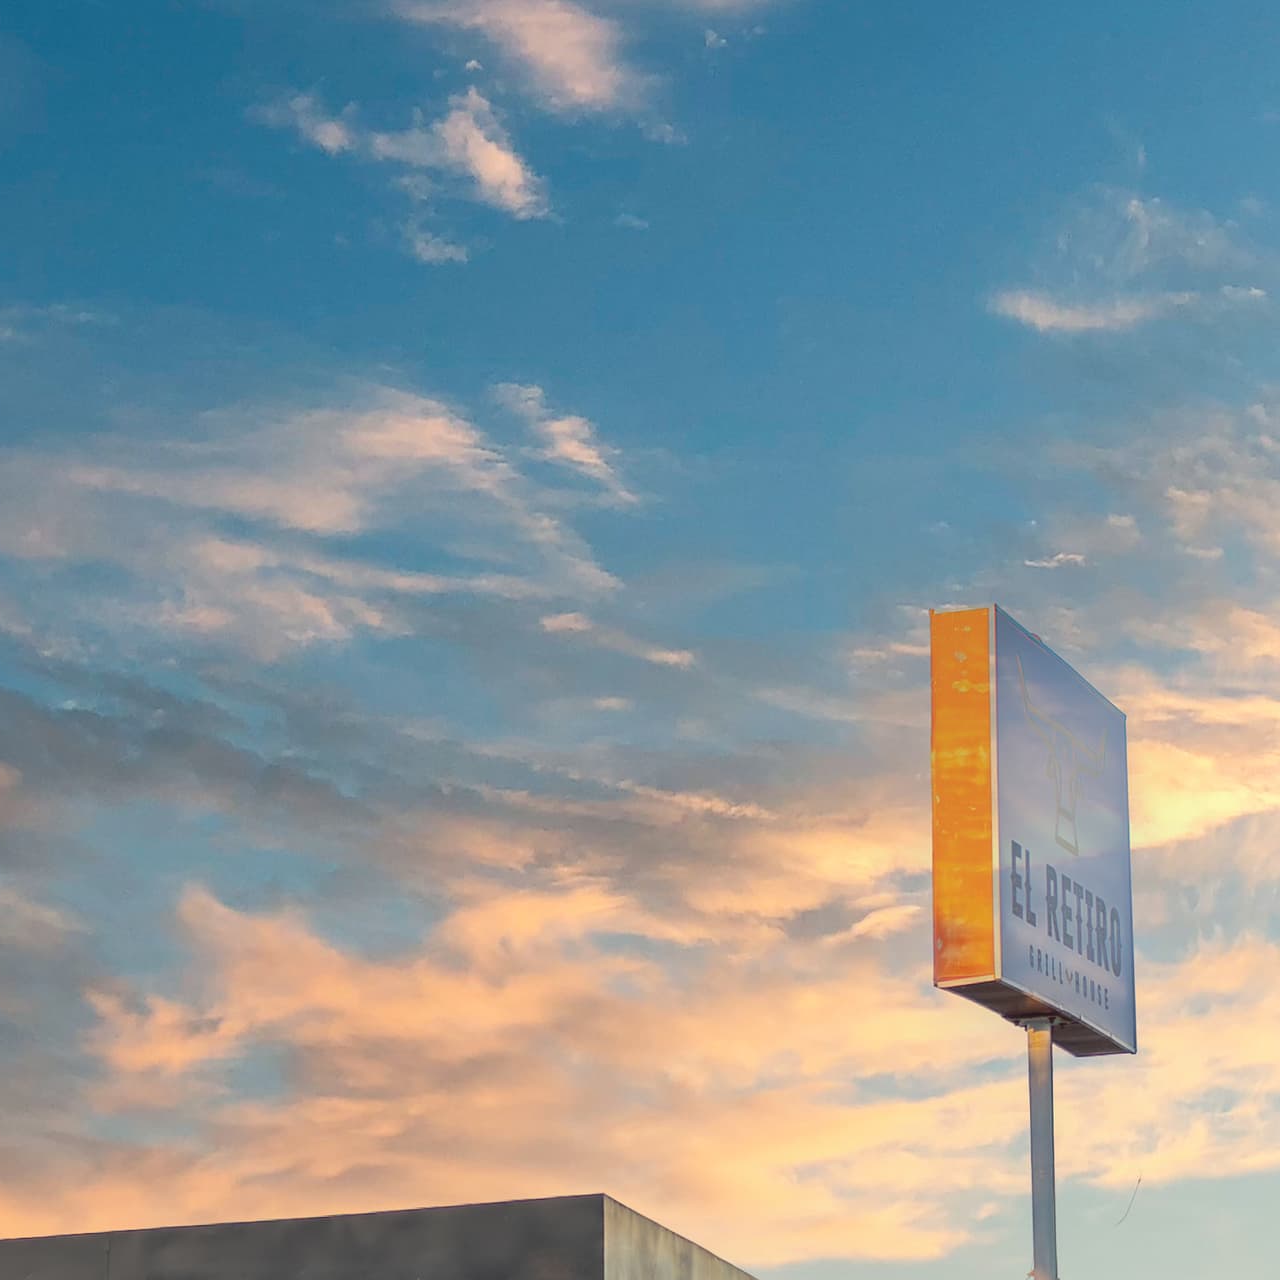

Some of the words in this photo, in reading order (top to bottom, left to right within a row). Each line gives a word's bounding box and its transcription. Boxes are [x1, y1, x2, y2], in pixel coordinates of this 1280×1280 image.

[1010, 839, 1037, 928] EL
[1046, 863, 1122, 978] RETIRO
[1029, 944, 1064, 986] GRILL
[1074, 970, 1109, 1010] HOUSE
